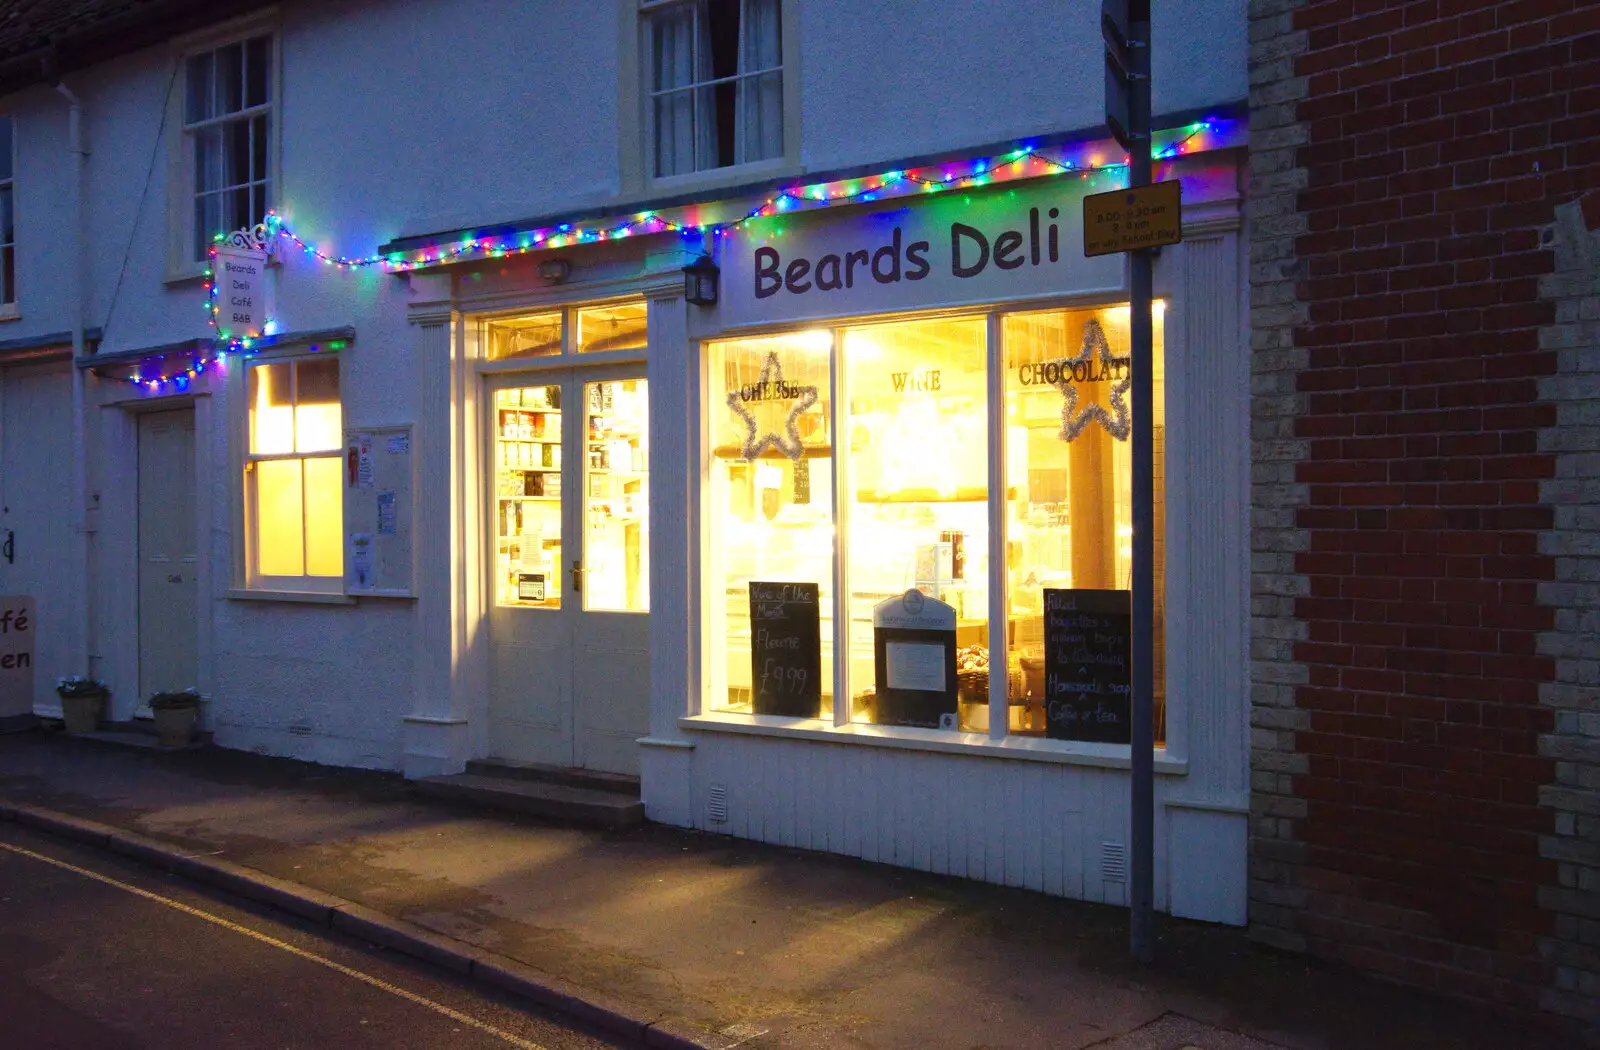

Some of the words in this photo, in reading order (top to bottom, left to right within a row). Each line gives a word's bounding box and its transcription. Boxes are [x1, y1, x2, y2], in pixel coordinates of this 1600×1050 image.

[1122, 229, 1154, 242] School
[754, 226, 931, 299] Beards
[951, 206, 1060, 279] Deli
[225, 262, 257, 276] Beards
[233, 280, 250, 291] Deli
[231, 296, 252, 308] Café
[233, 312, 251, 324] B&B
[891, 370, 941, 393] WINE
[740, 379, 800, 402] CHEESE
[0, 652, 31, 670] en
